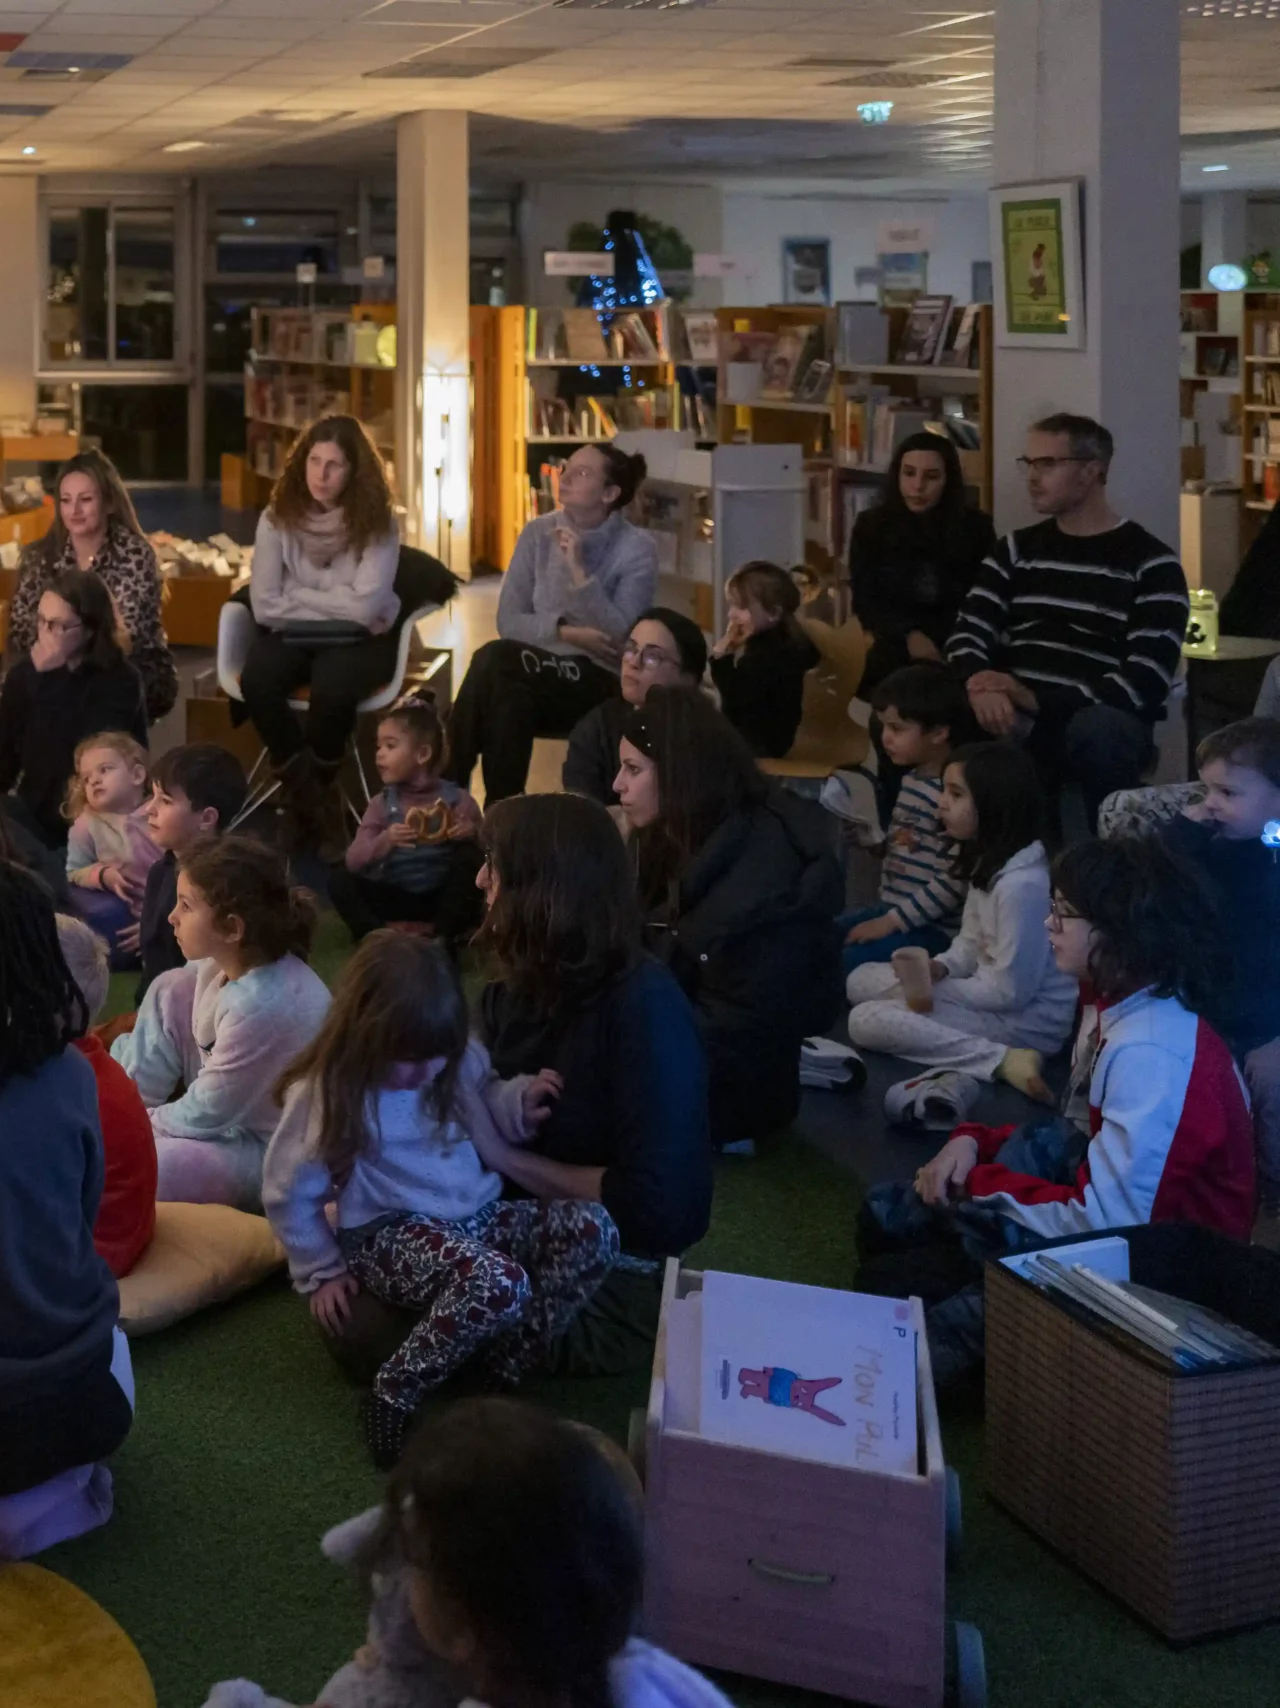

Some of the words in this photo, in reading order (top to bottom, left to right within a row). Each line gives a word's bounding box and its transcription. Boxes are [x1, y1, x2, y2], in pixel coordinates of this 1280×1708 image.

[893, 1326, 906, 1338] P
[853, 1345, 883, 1408] MON
[854, 1418, 884, 1462] PUL
